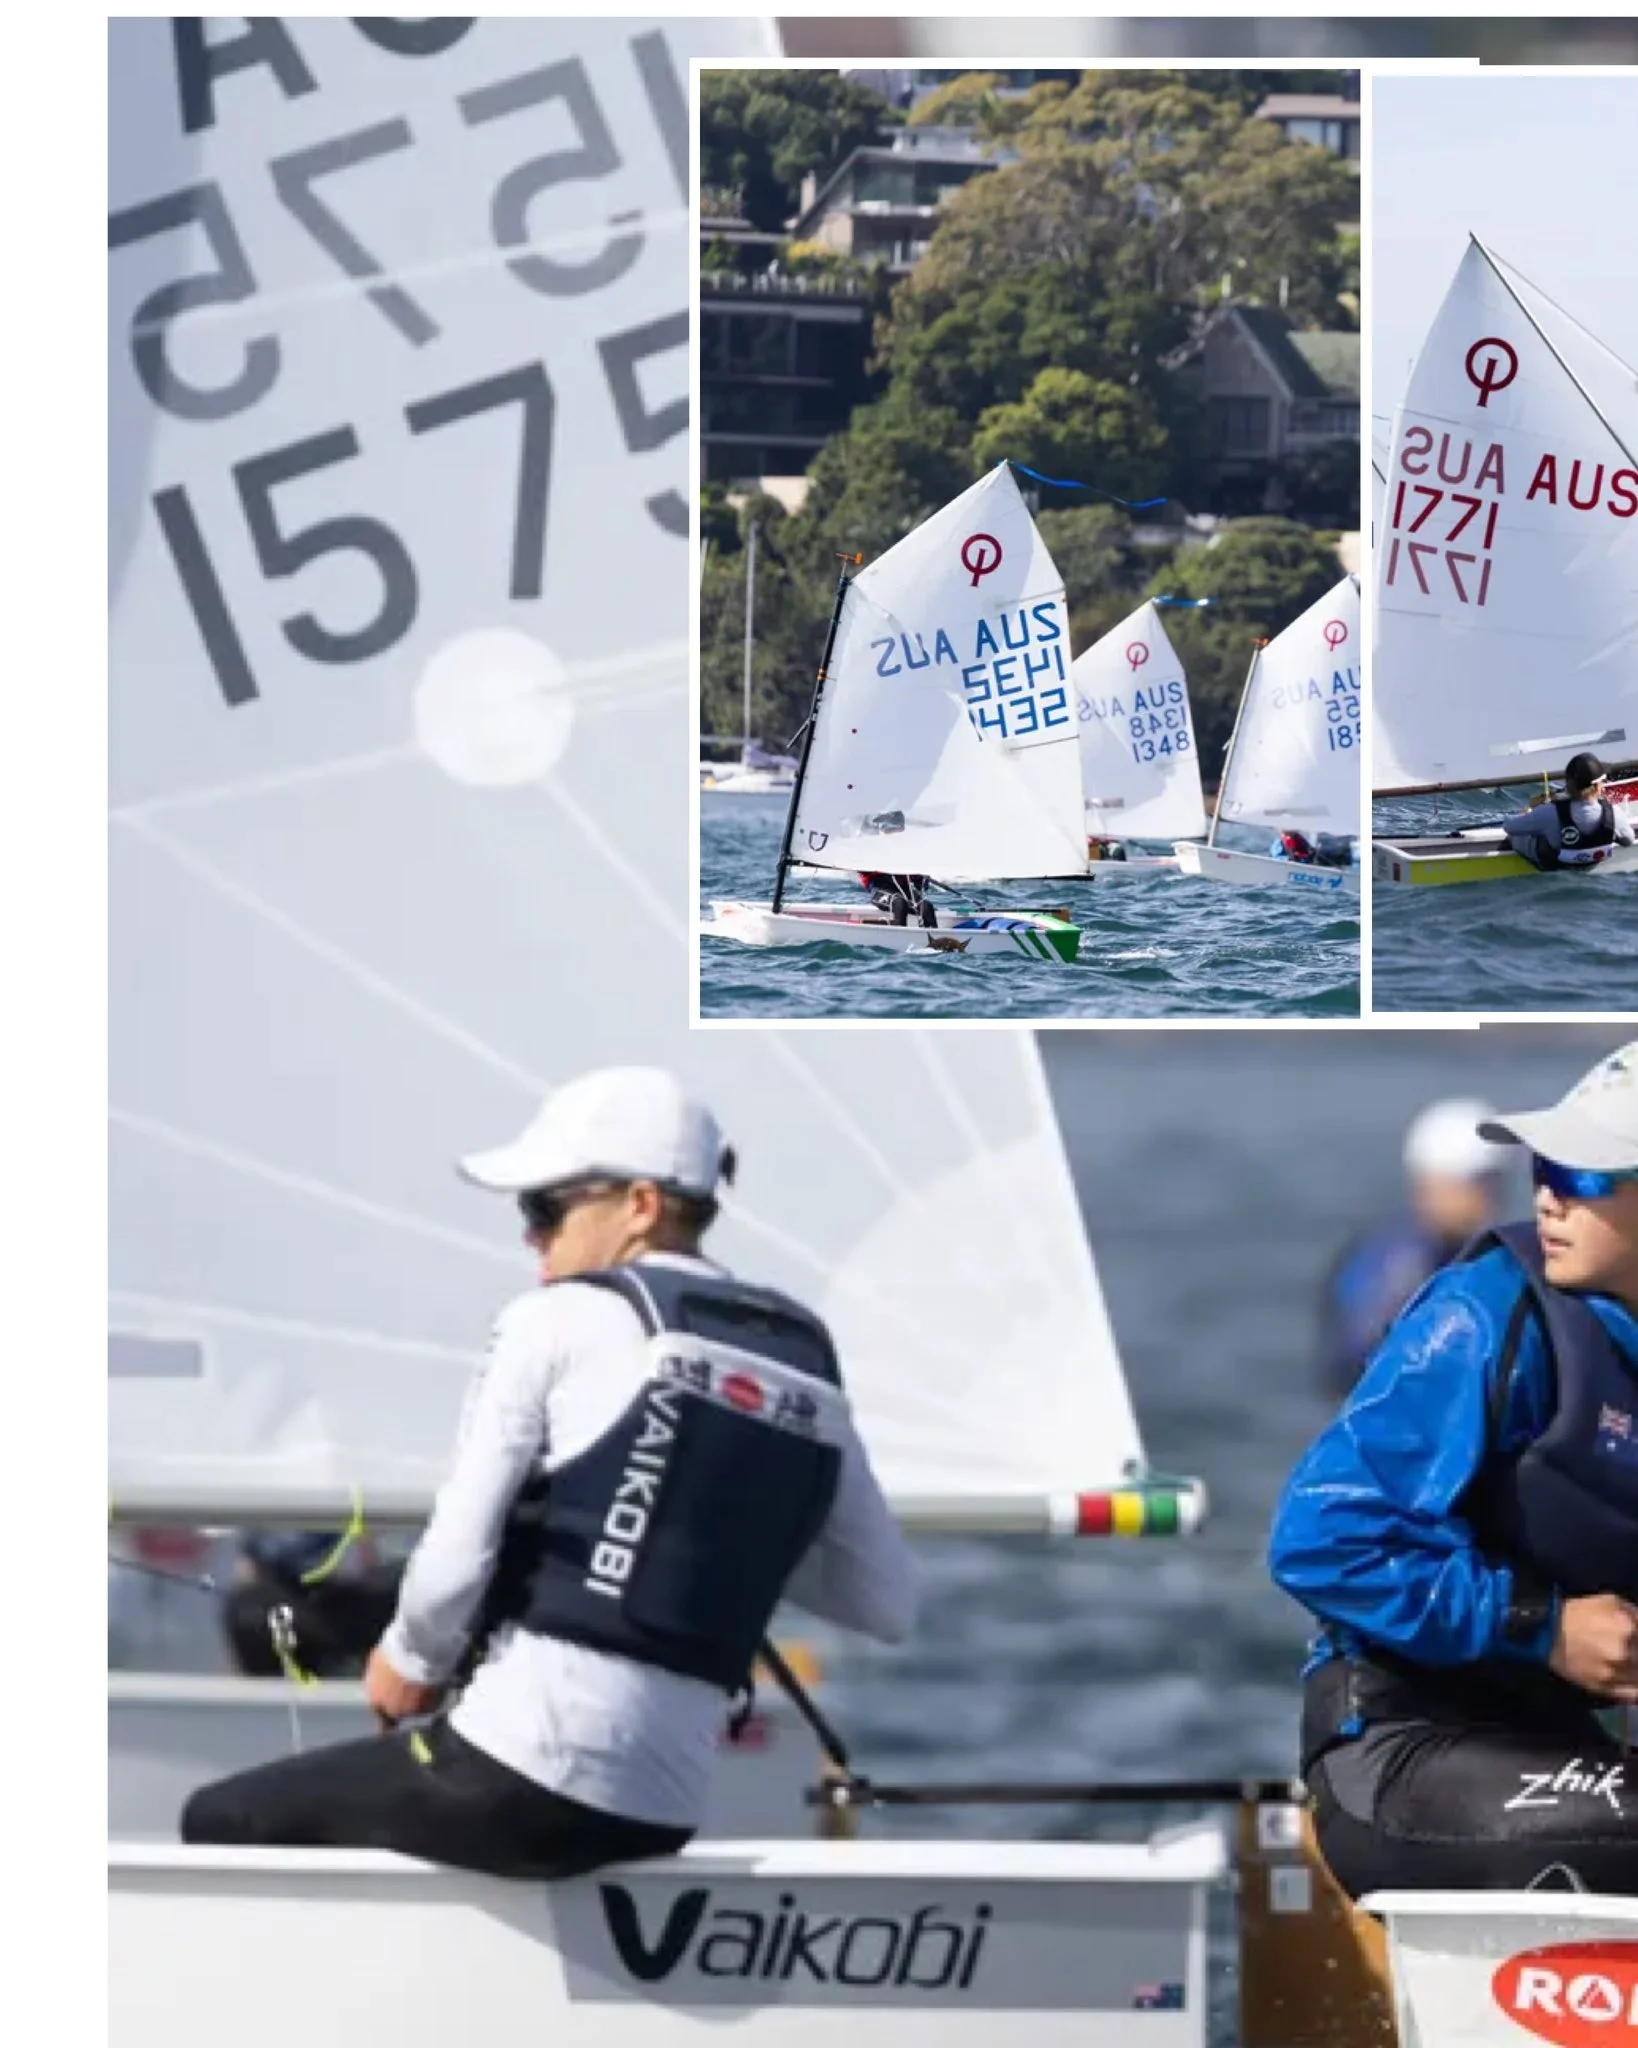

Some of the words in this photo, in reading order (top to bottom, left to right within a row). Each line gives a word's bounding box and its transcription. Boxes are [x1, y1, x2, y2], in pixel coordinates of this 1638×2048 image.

[1392, 479, 1499, 551] 1771
[1526, 453, 1638, 518] AUS
[975, 601, 1061, 659] AUS
[1134, 681, 1185, 714] AUS
[1131, 730, 1191, 763] 1348
[1327, 721, 1360, 752] 18
[582, 1385, 682, 1599] VAIKOBI
[599, 1883, 993, 1990] Vaikobi
